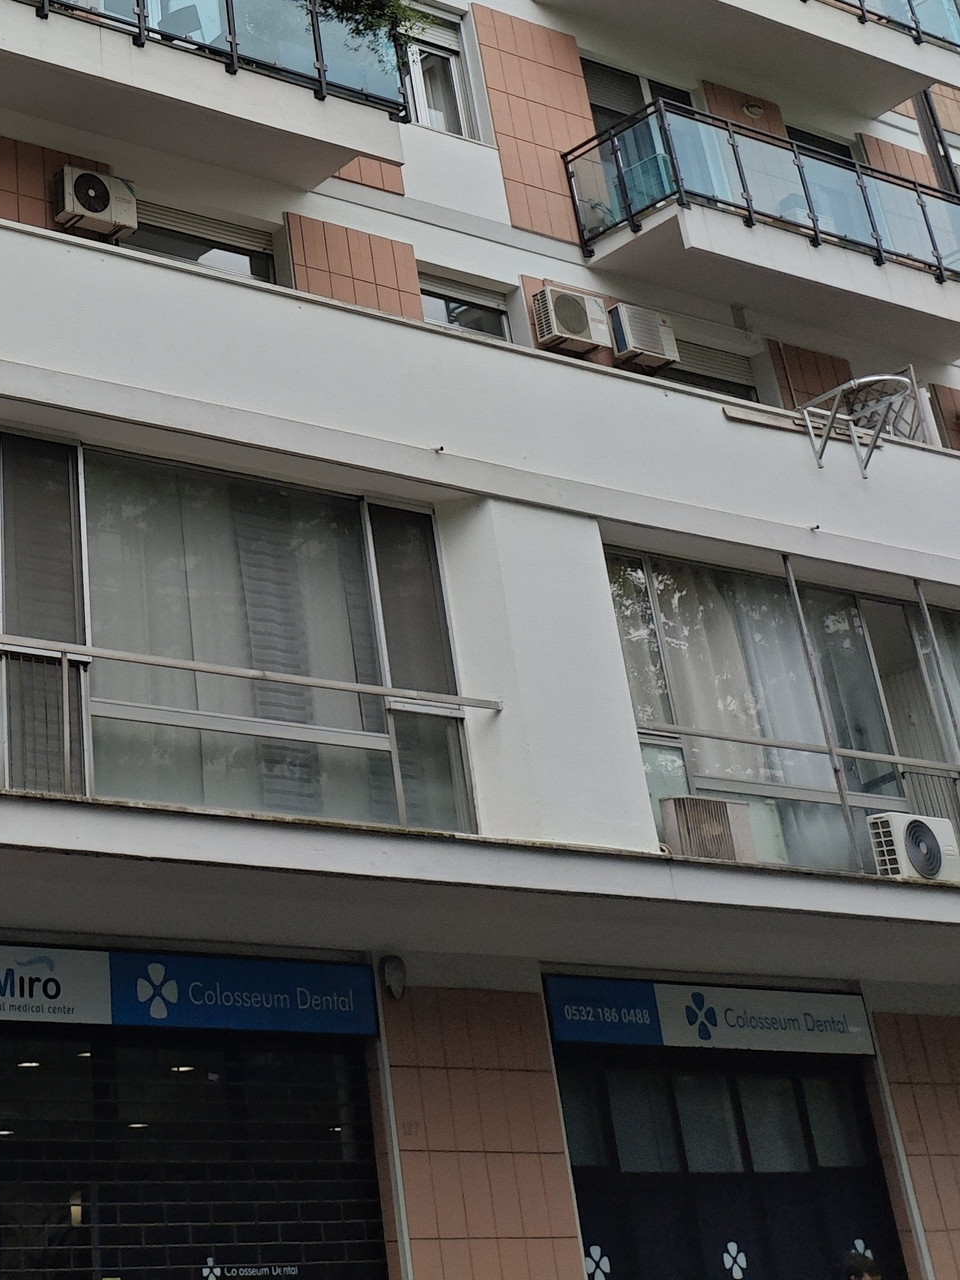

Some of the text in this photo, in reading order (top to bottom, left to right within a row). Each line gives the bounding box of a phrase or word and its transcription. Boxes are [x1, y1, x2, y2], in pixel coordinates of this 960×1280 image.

[188, 980, 354, 1012] Colosseum Dental
[8, 1003, 44, 1014] medical
[47, 1005, 76, 1015] center
[563, 1004, 651, 1025] 0532 186 0488
[724, 1007, 851, 1034] Colosseum Dental
[224, 1267, 270, 1277] Coosseum
